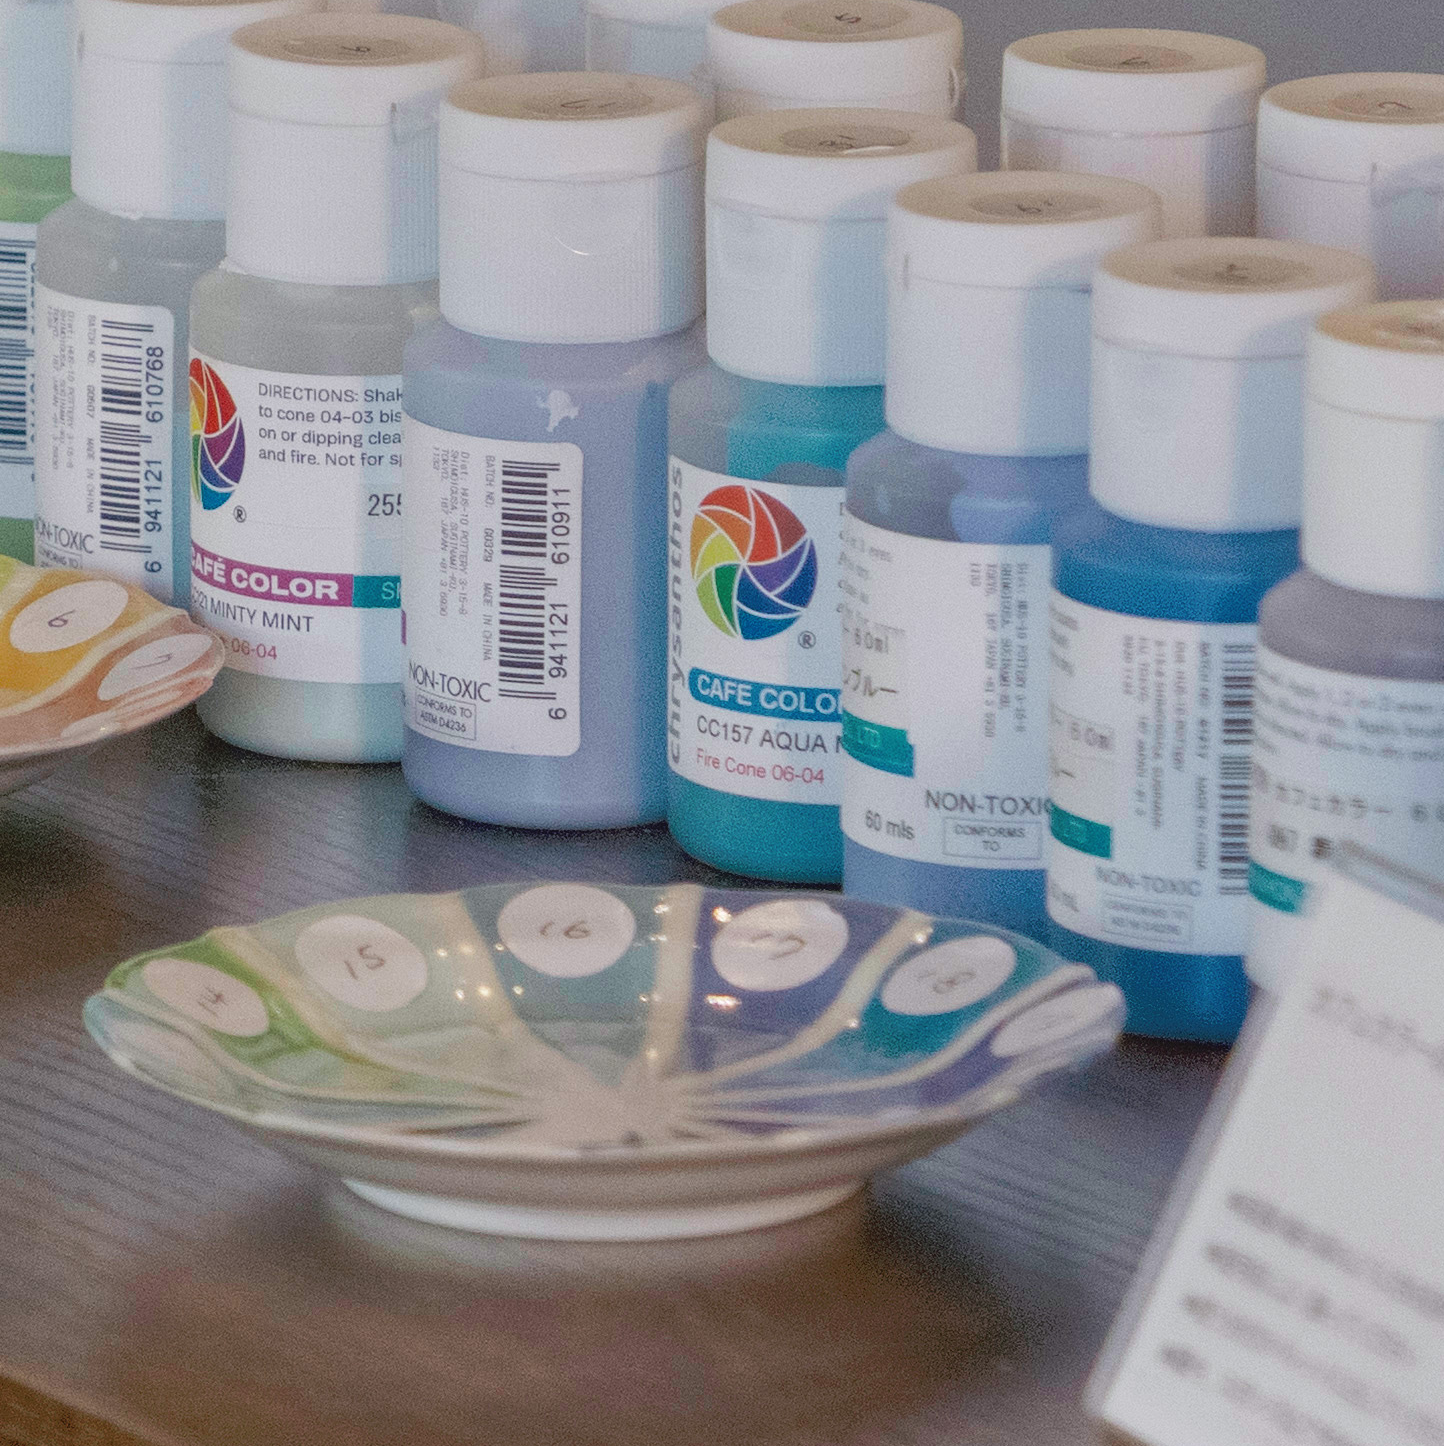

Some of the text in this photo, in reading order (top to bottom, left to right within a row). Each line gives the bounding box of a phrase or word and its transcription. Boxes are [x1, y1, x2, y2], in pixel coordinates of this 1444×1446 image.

[258, 382, 358, 403] DIRECTIONS:
[259, 404, 273, 419] to
[277, 408, 315, 424] cone
[259, 427, 277, 440] on
[281, 429, 297, 442] or
[301, 429, 364, 448] dipping
[144, 346, 164, 573] 6 941121 610768
[259, 447, 286, 463] and
[289, 448, 320, 465] fire.
[325, 452, 356, 467] Not
[360, 452, 384, 467] for
[485, 455, 495, 486] BATCH
[36, 517, 94, 554] ON-TOXIC
[230, 567, 340, 601] COLOR
[380, 581, 402, 601] S
[483, 582, 493, 606] MADE
[47, 609, 76, 628] 6
[210, 597, 315, 632] MINTY MINT
[483, 614, 492, 625] IN
[548, 488, 571, 720] 6 941121 610911
[669, 464, 689, 765] chrysanthos
[231, 636, 278, 660] 06-04
[482, 629, 491, 661] CHINA
[408, 659, 492, 703] NON-TOXIC
[696, 673, 753, 707] CAFE
[459, 706, 473, 719] TO
[696, 714, 754, 745] CC157
[759, 728, 829, 755] AQUA
[696, 748, 825, 785] Fire Cone 06-04
[864, 809, 882, 832] 60
[982, 840, 1001, 852] TO
[538, 919, 591, 941] 16
[343, 943, 386, 981] 15
